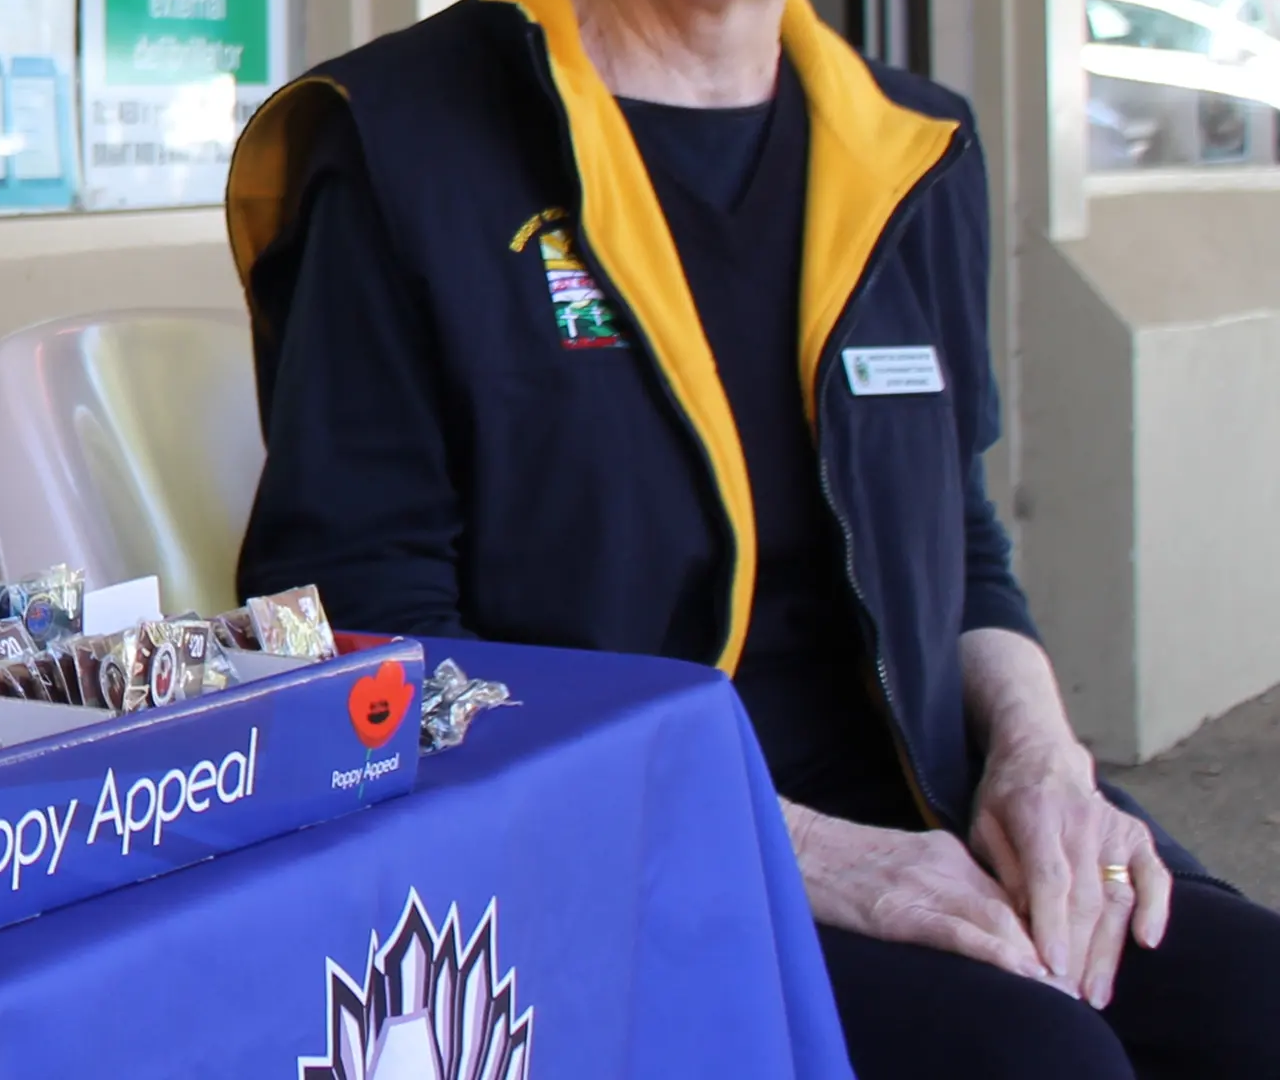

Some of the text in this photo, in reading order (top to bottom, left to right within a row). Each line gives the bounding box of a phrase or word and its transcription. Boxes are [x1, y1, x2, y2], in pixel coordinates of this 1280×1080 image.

[86, 726, 258, 857] Appeal
[330, 752, 400, 791] Poppy Appeal
